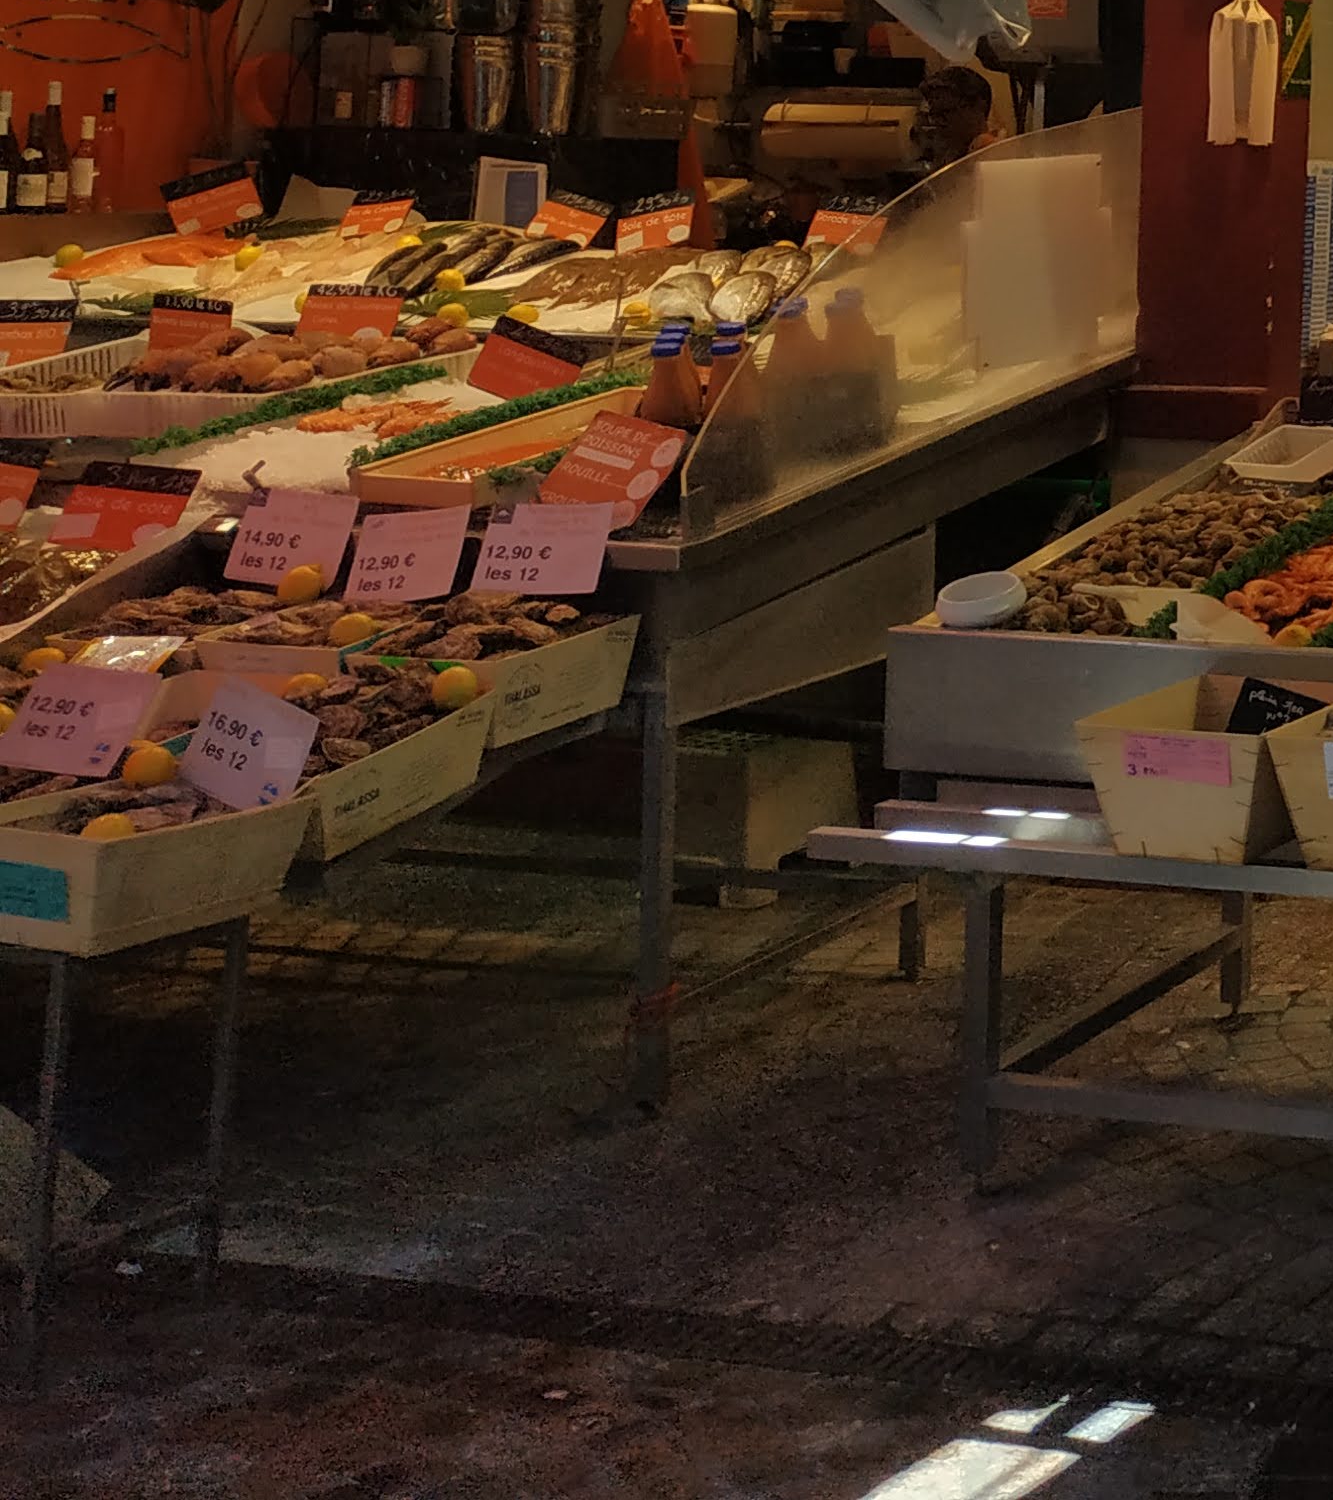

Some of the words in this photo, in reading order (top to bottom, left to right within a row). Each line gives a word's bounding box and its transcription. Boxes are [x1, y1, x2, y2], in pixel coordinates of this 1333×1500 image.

[244, 530, 284, 548] 14,90
[288, 534, 301, 550] €
[240, 551, 267, 568] les
[269, 556, 287, 571] 12
[486, 544, 533, 561] 12,90
[538, 545, 552, 560] €
[358, 556, 400, 572] 12,90
[403, 553, 416, 567] €
[485, 565, 516, 581] les
[519, 567, 539, 582] 12
[358, 577, 385, 593] les
[388, 576, 406, 590] 12
[29, 696, 75, 716] 12,90
[80, 701, 95, 717] €
[22, 722, 49, 739] les
[55, 724, 76, 741] 12
[208, 711, 248, 740] 16,90
[250, 730, 264, 746] €
[201, 737, 224, 762] les
[228, 750, 248, 771] 12
